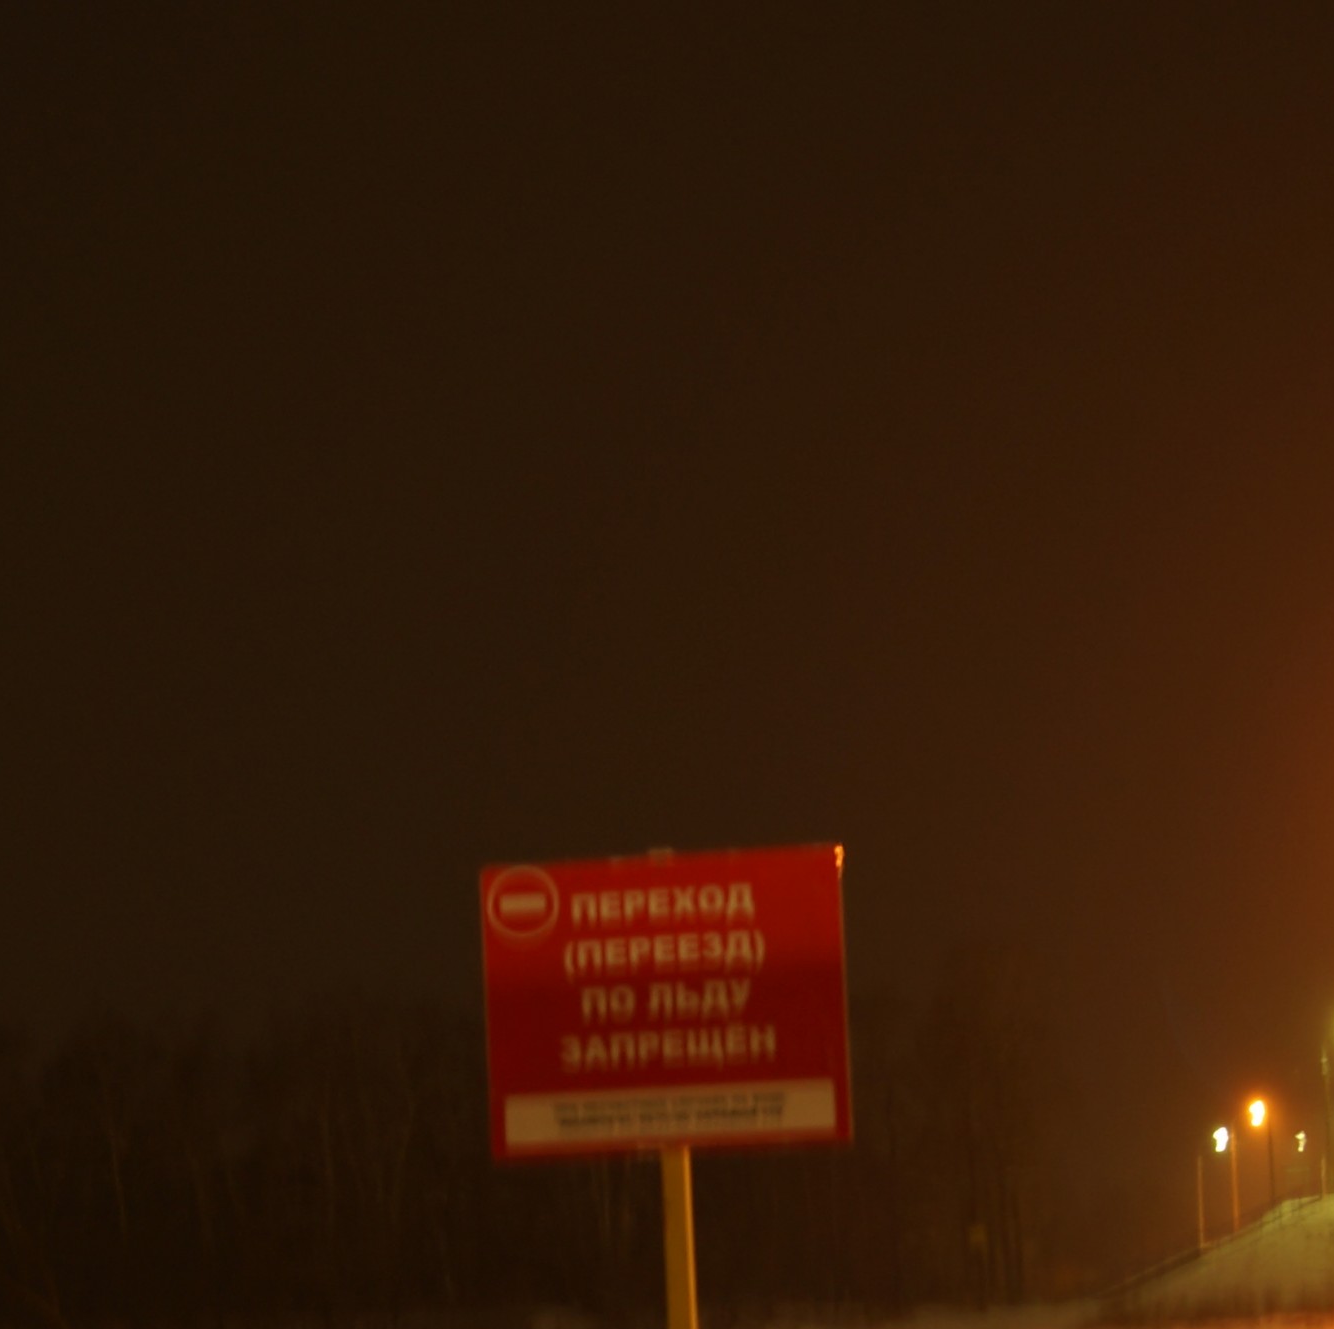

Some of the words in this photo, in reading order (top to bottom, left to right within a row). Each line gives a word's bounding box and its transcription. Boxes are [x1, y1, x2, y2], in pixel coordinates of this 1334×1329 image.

[571, 882, 755, 928] ПЕРЕХОД
[564, 929, 765, 979] (ПЕРЕЕЗД)
[581, 984, 635, 1023] ПО
[648, 978, 750, 1019] ЛЬДУ
